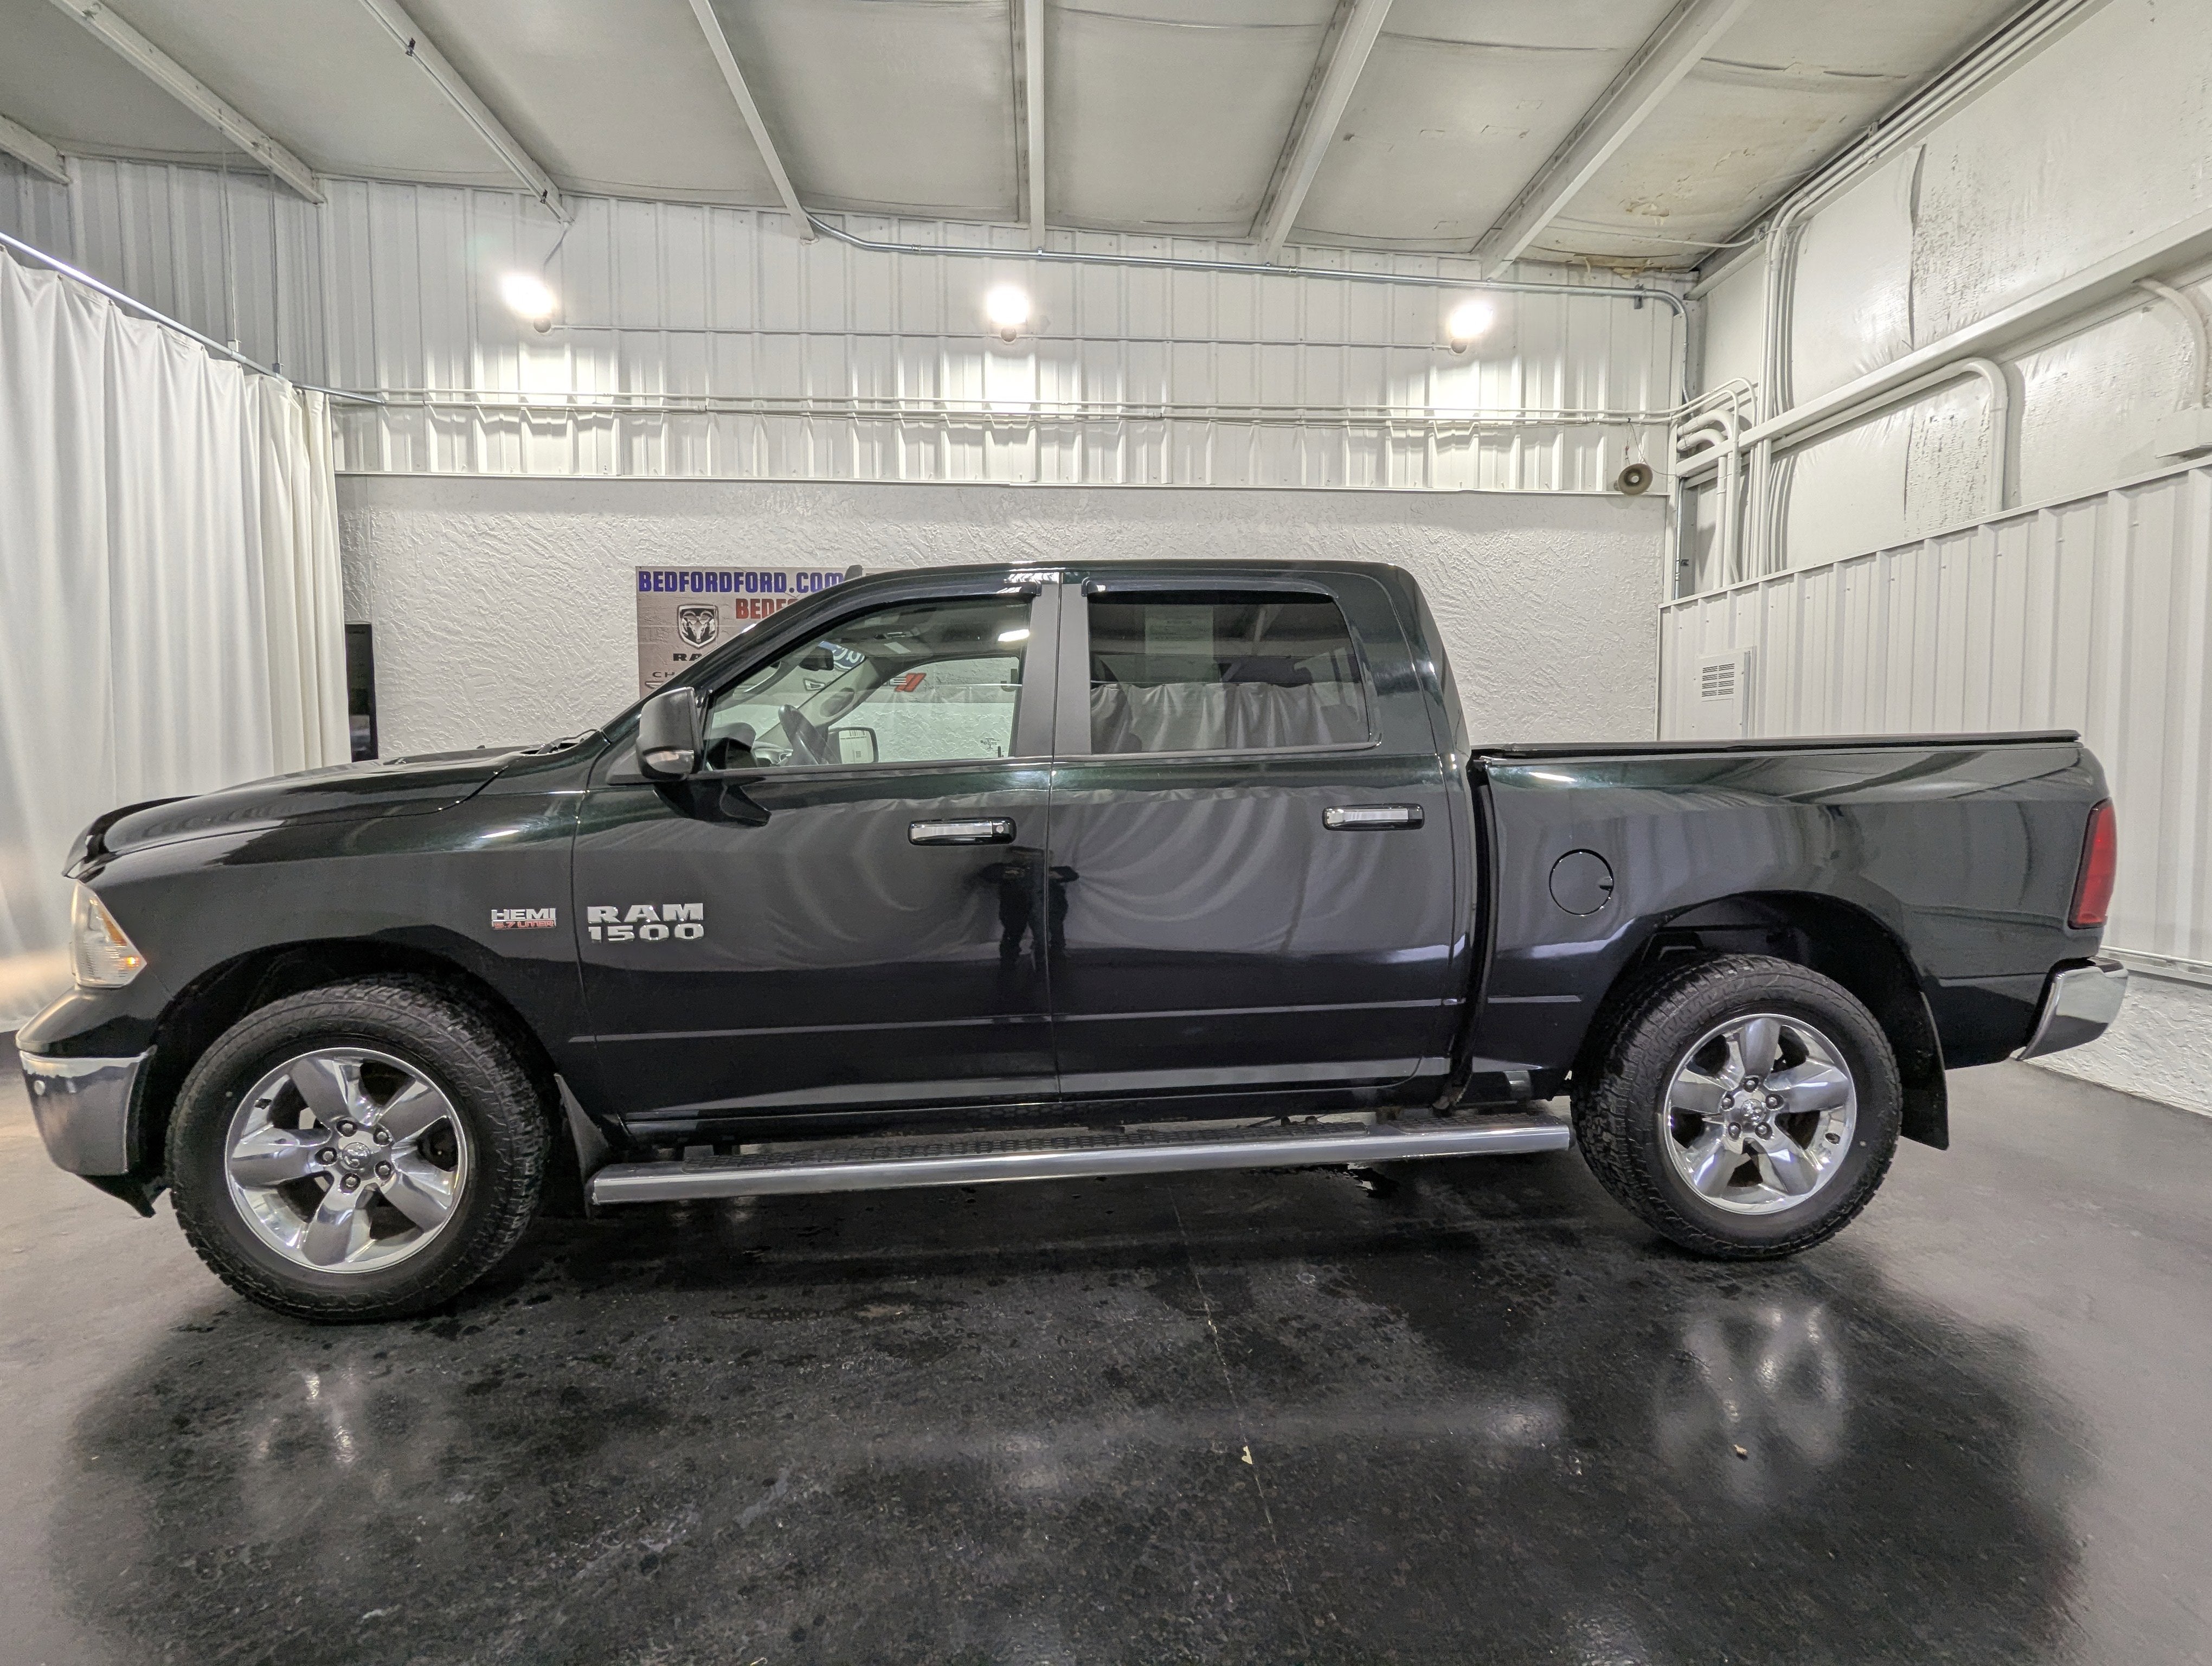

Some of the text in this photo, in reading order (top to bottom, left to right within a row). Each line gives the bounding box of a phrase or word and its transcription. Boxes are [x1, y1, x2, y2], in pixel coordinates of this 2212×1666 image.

[639, 571, 845, 593] BEDFORDFORD.COM
[736, 598, 798, 619] BEDF
[673, 653, 702, 661] RA
[491, 908, 556, 920] HEMI
[587, 903, 703, 923] RAM
[588, 923, 704, 943] 1500
